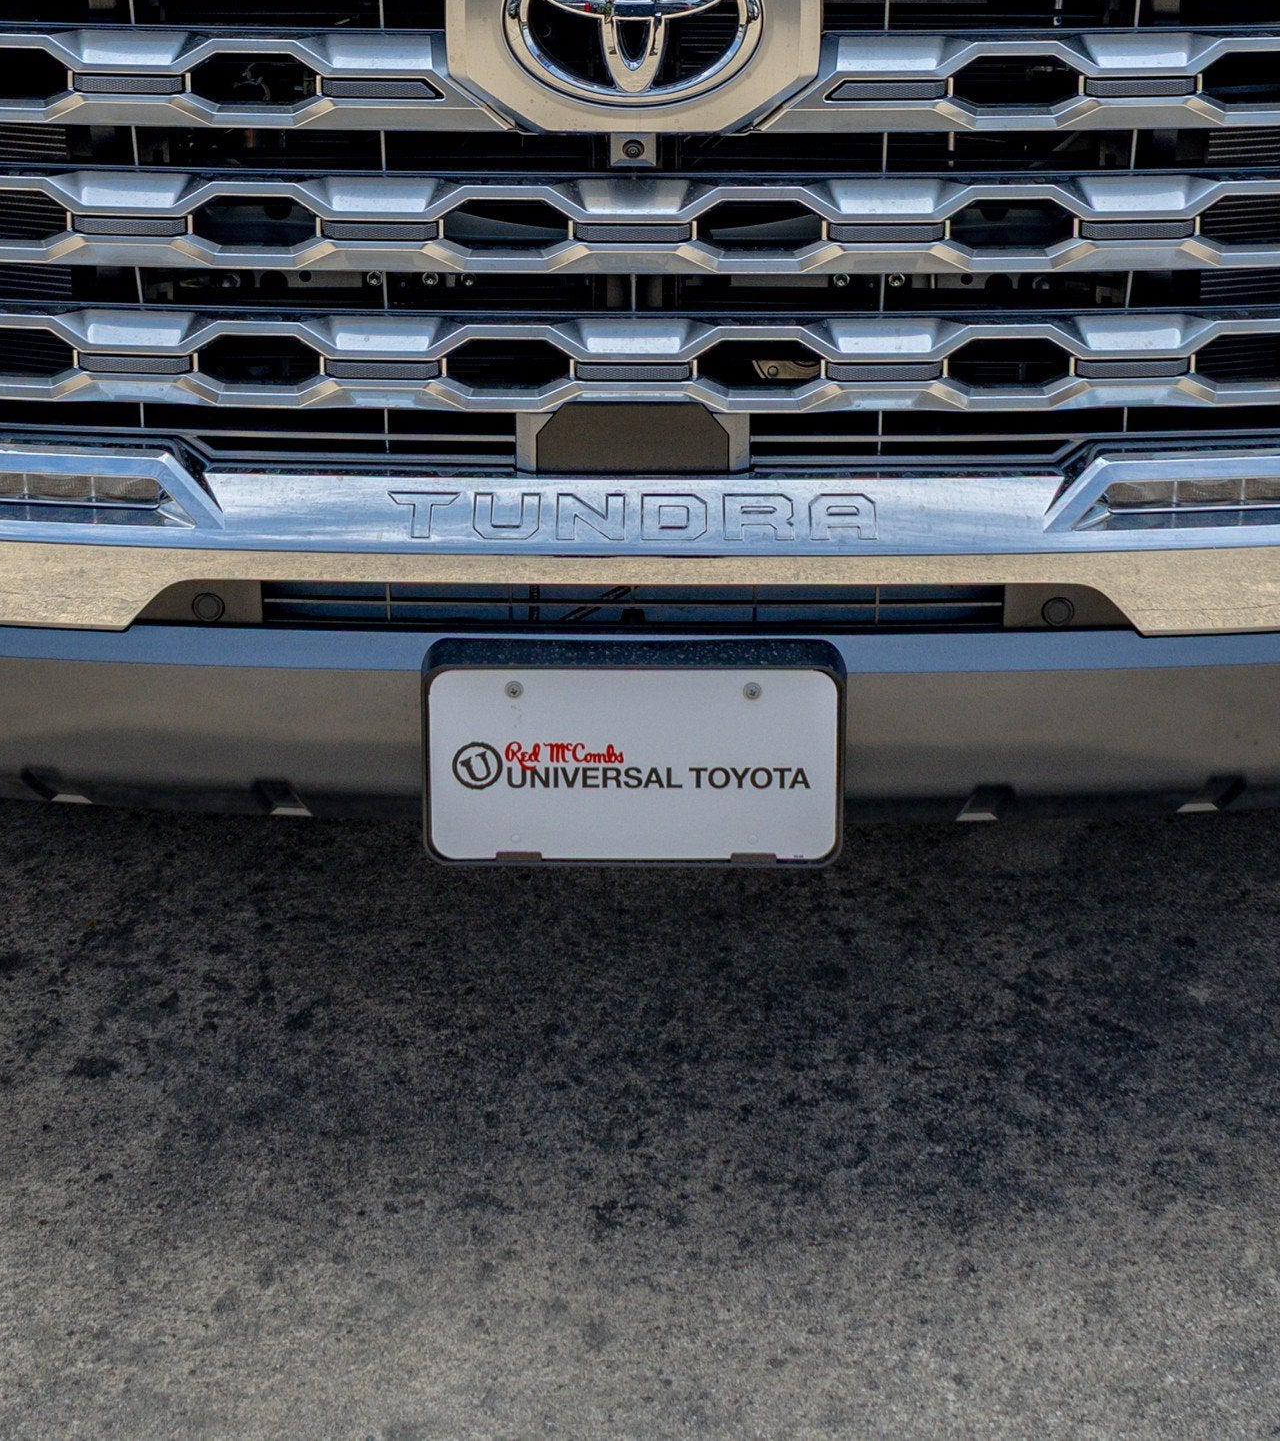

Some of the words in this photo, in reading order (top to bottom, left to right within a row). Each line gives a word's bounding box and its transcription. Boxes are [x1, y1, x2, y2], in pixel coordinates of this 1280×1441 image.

[387, 491, 879, 541] TUNDRA
[505, 741, 541, 771] Red
[543, 742, 624, 764] McCombs
[506, 766, 683, 789] UNIVERSAL
[689, 766, 811, 789] TOYOTA
